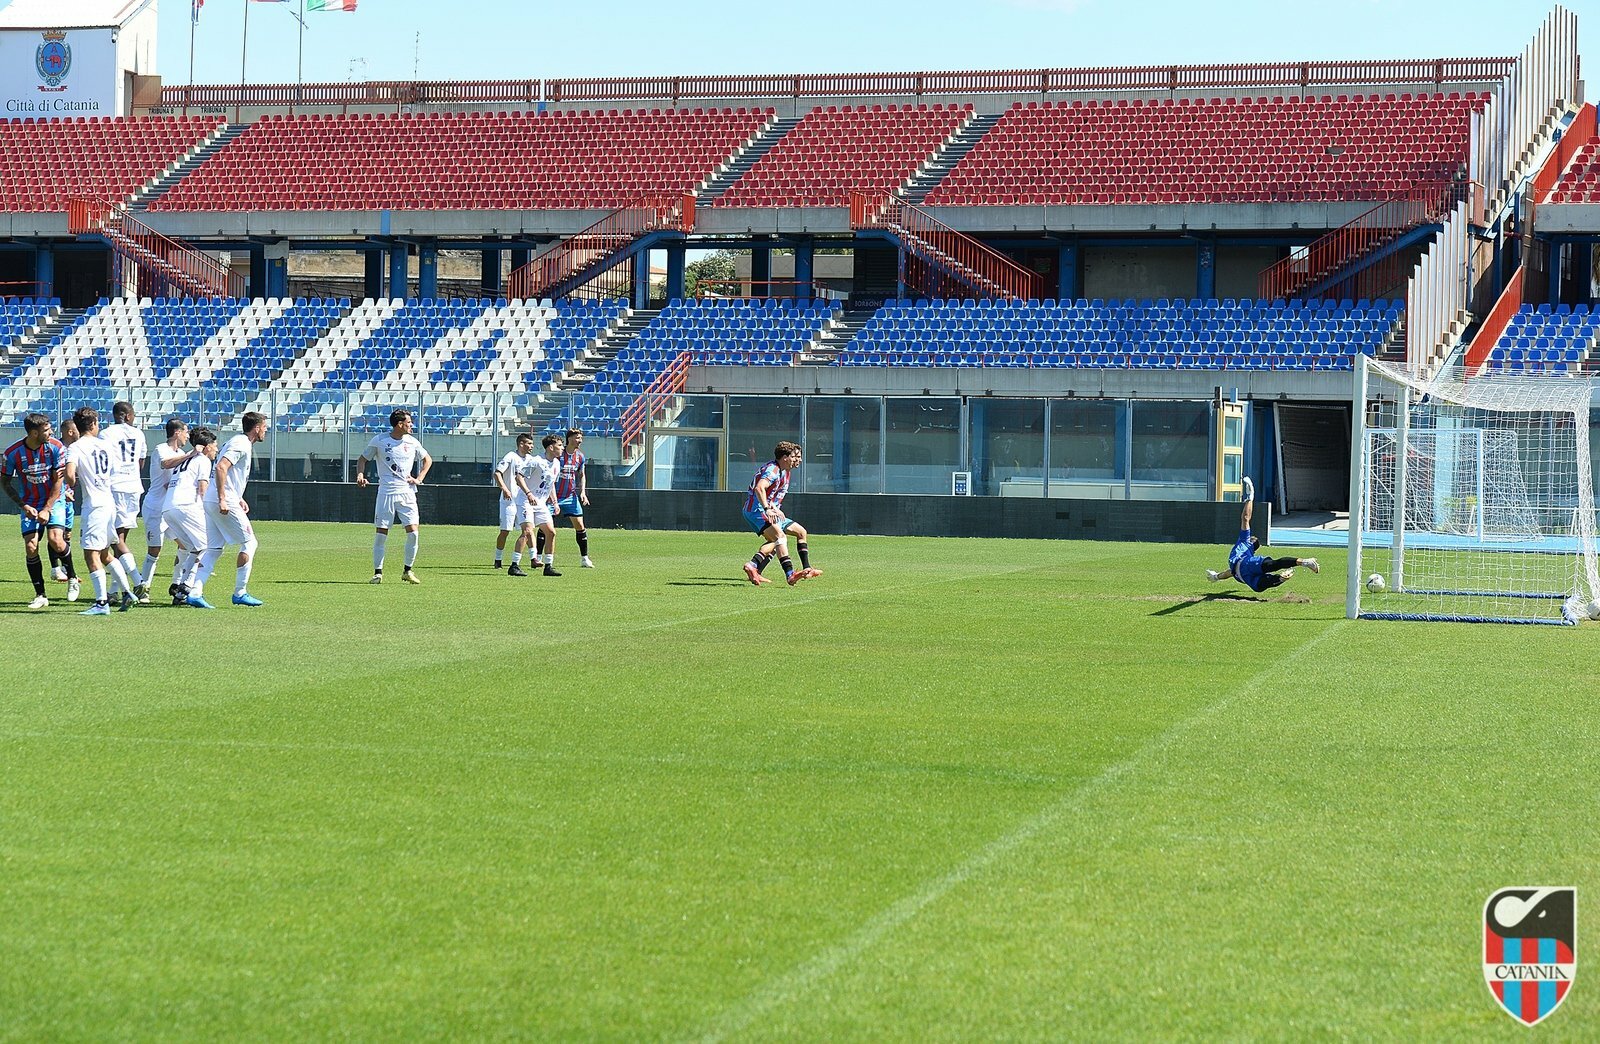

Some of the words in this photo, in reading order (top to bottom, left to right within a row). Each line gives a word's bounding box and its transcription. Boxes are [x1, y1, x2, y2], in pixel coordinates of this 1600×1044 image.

[6, 99, 35, 112] Città
[38, 99, 50, 112] di
[53, 98, 100, 111] Catania
[91, 449, 109, 475] 10
[118, 438, 136, 462] 17
